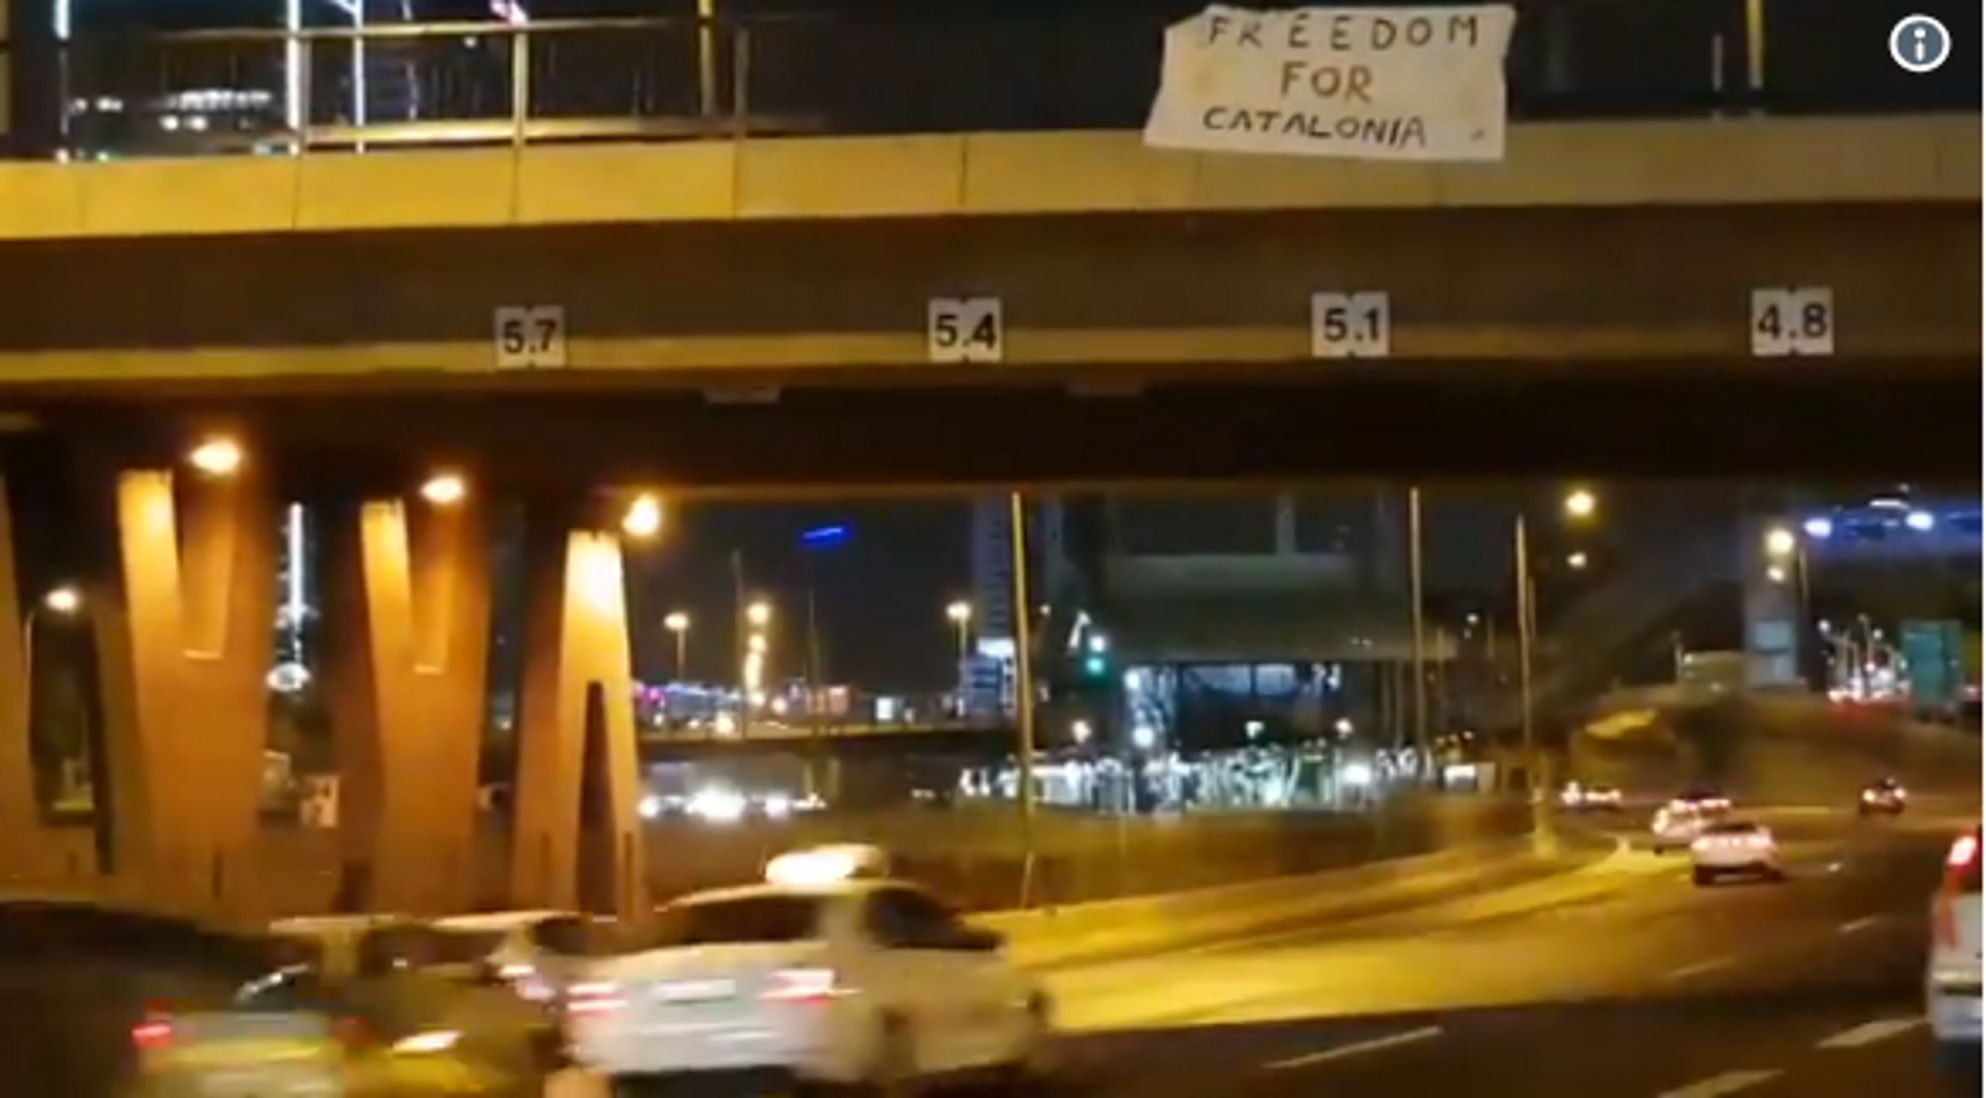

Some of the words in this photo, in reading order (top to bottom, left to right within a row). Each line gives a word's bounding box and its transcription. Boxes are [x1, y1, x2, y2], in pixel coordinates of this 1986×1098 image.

[1208, 14, 1479, 51] FREEDOM
[1280, 60, 1372, 104] FOR
[1202, 106, 1427, 148] CATALONIA
[502, 318, 558, 354] 5.7
[935, 312, 997, 349] 5.4
[1323, 307, 1382, 343] 5.1
[1757, 303, 1828, 341] 4.8
